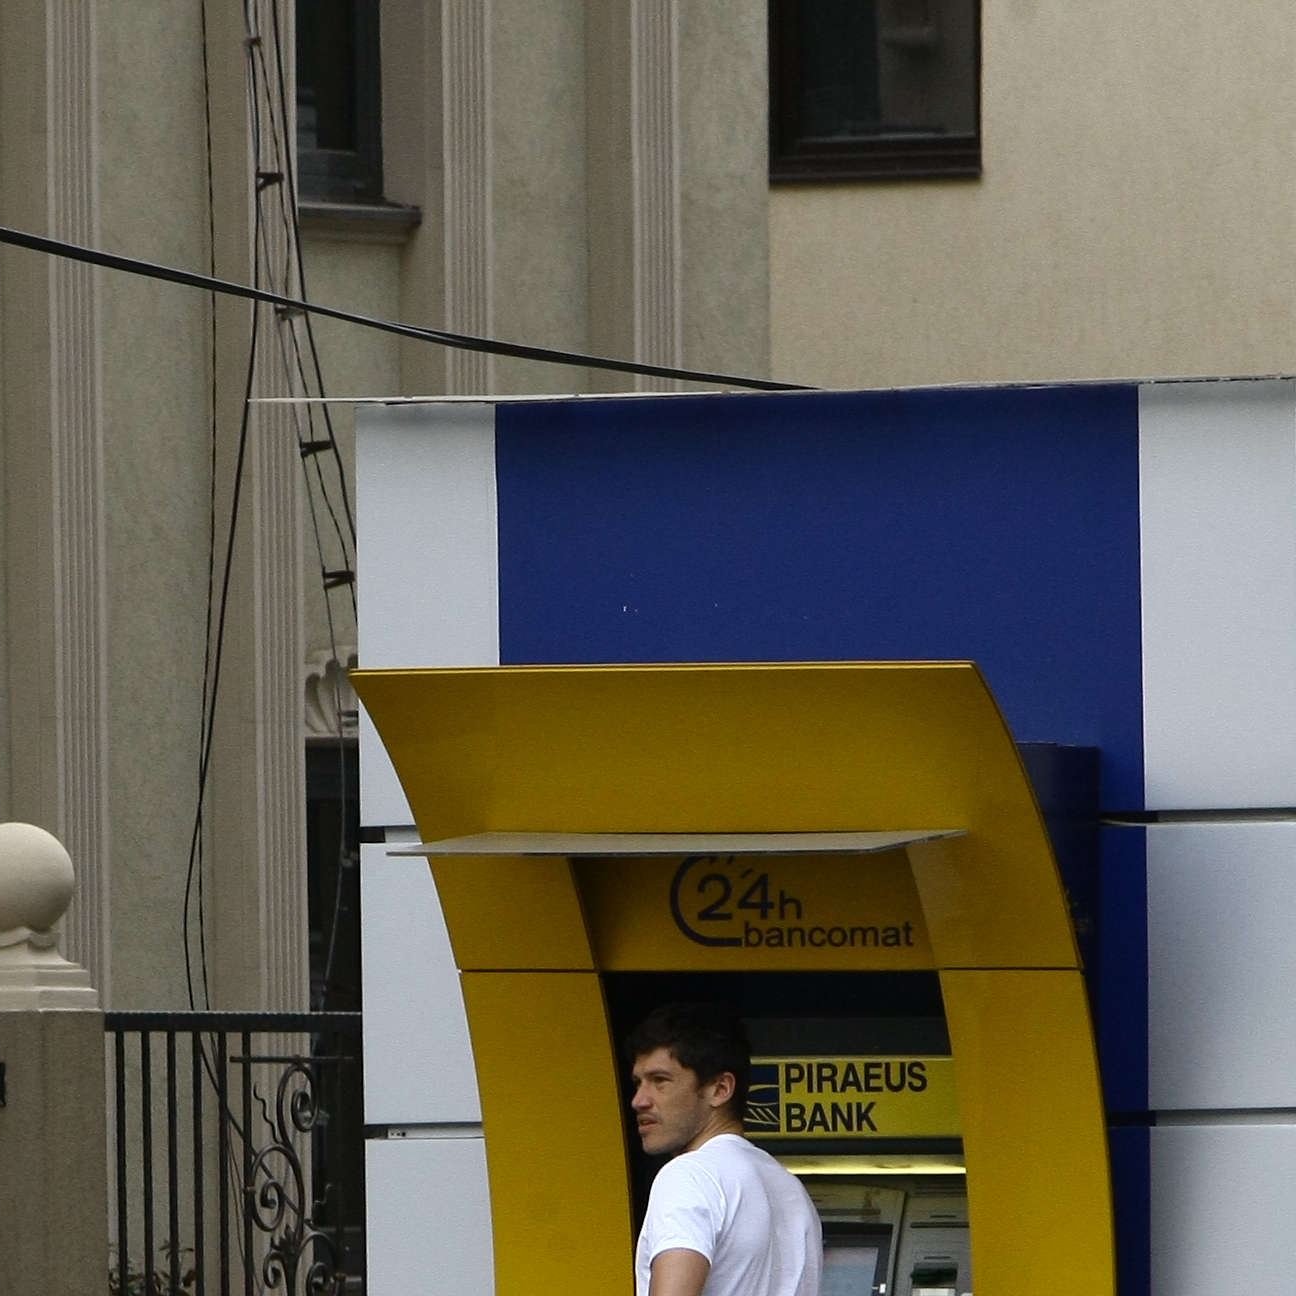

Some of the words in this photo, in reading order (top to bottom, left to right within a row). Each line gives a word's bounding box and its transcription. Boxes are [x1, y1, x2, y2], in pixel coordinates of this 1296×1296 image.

[744, 921, 913, 948] bancomat
[785, 1061, 927, 1093] PIRAEUS
[785, 1102, 878, 1132] BANK
